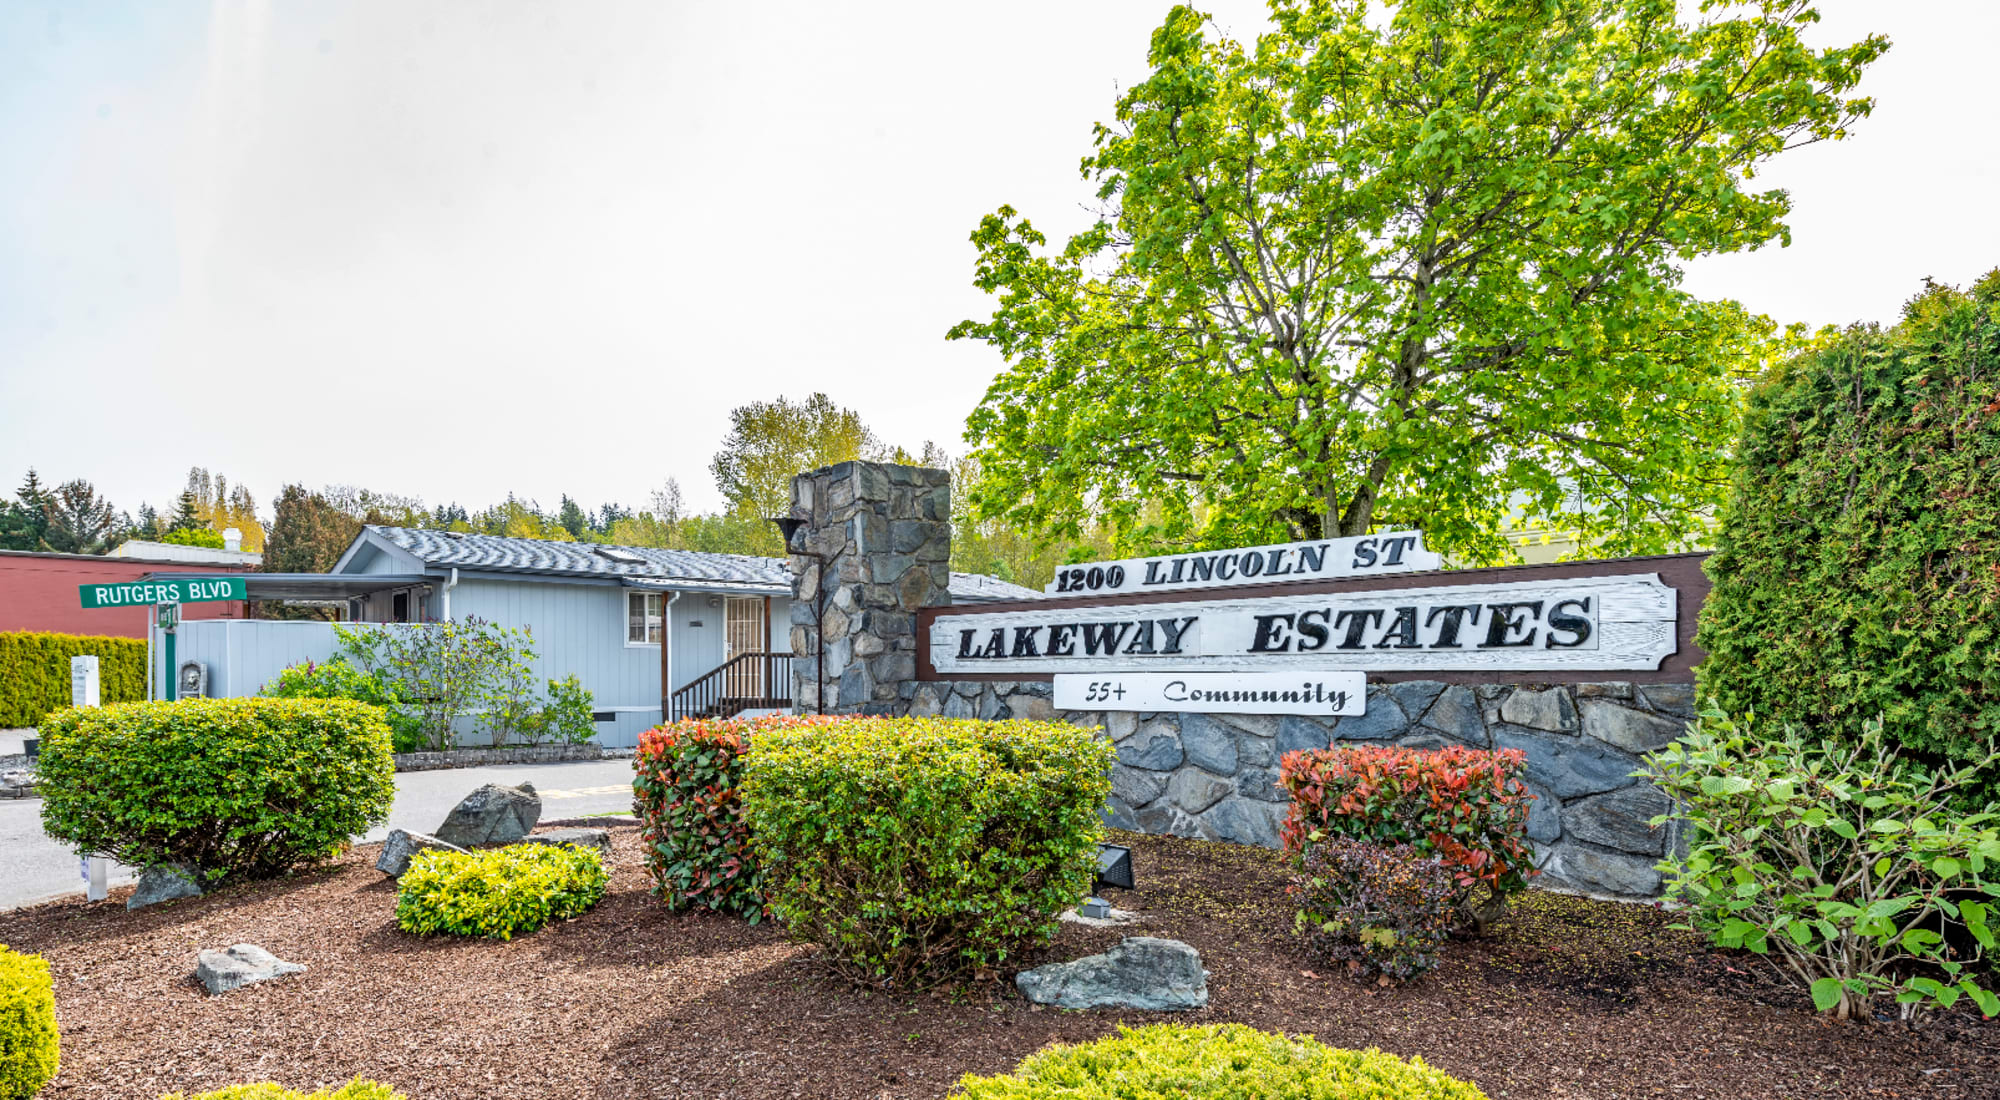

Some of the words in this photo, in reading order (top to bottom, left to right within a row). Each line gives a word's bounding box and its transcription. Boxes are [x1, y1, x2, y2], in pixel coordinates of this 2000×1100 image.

[1056, 565, 1125, 592] 1200
[1142, 544, 1330, 585] LINCOLN
[1352, 537, 1416, 569] ST
[95, 584, 180, 605] RUTGERS
[189, 581, 232, 599] BLVD
[955, 616, 1199, 659] LAKEWAY
[1247, 596, 1593, 653] ESTATES
[1085, 682, 1127, 702] 55+
[1163, 680, 1353, 712] Community
